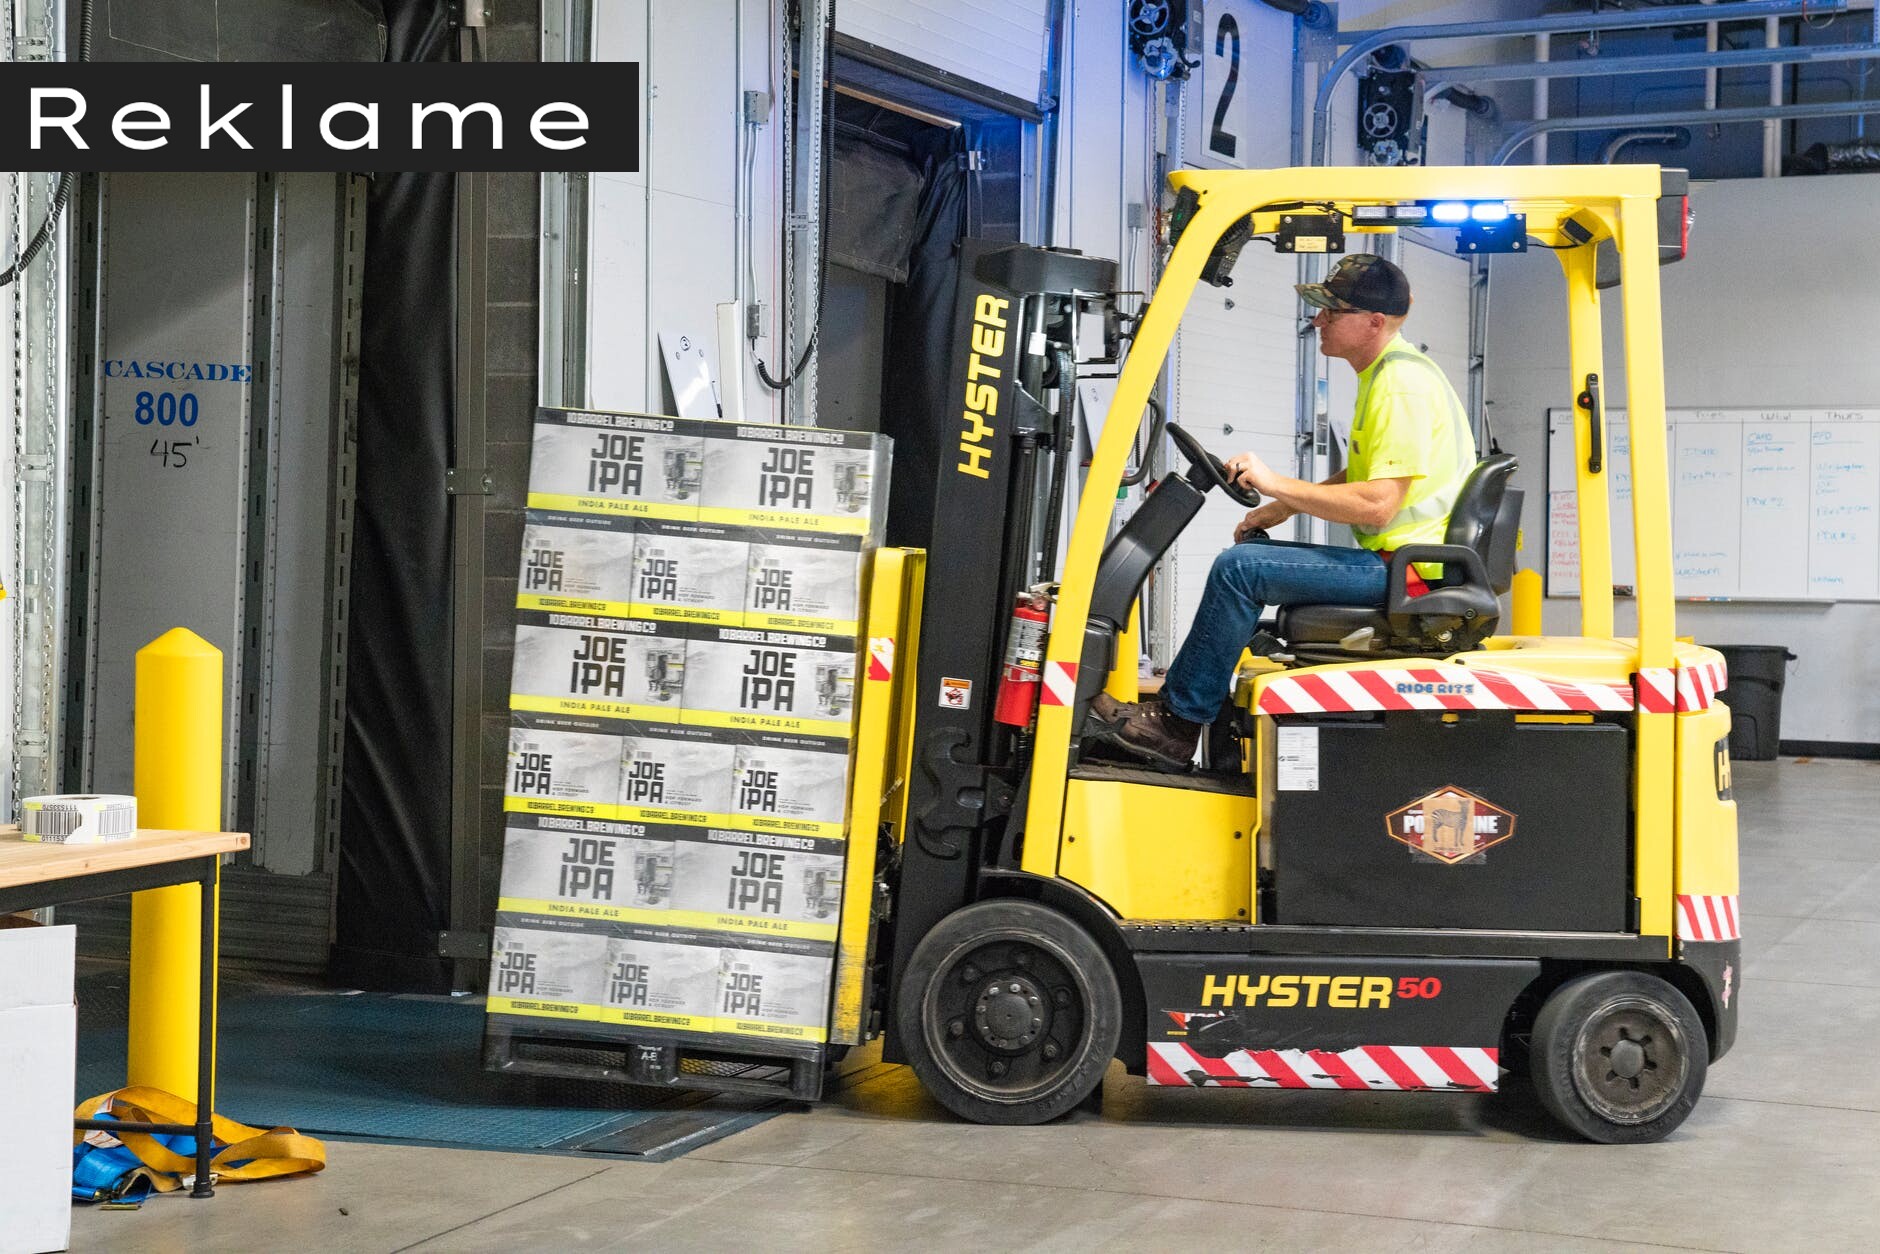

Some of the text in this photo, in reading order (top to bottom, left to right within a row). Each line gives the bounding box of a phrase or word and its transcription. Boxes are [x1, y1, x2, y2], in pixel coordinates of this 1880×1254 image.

[1210, 13, 1240, 158] 2
[105, 360, 252, 382] CASCADE
[957, 294, 1009, 479] HYSTER
[135, 391, 198, 426] 800
[150, 435, 199, 468] 45'
[591, 433, 645, 462] JOE
[762, 447, 814, 475] JOE
[588, 460, 643, 496] IPA
[758, 474, 813, 509] IPA
[578, 500, 604, 508] INDIA
[608, 502, 628, 510] PALE
[528, 550, 564, 568] JOE
[642, 559, 678, 578] JOE
[526, 567, 562, 591] IPA
[640, 577, 677, 600] IPA
[756, 569, 792, 587] JOE
[754, 587, 790, 610] IPA
[574, 635, 627, 663] JOE
[744, 650, 796, 678] JOE
[570, 662, 625, 697] IPA
[1397, 683, 1433, 693] RIDE
[740, 676, 794, 712] IPA
[560, 701, 586, 709] INDIA
[590, 704, 610, 712] PALE
[730, 716, 756, 724] INDIA
[516, 753, 552, 772] JOE
[629, 761, 665, 780] JOE
[514, 771, 551, 794] IPA
[627, 779, 663, 803] IPA
[742, 770, 778, 789] JOE
[740, 788, 776, 812] IPA
[562, 838, 616, 866] JOE
[731, 851, 785, 880] JOE
[559, 865, 614, 900] IPA
[728, 878, 782, 914] IPA
[549, 904, 574, 912] INDIA
[579, 907, 599, 915] PALE
[717, 918, 788, 930] INDIA PALE ALE
[500, 952, 536, 971] JOE
[613, 963, 649, 982] JOE
[498, 970, 535, 994] IPA
[610, 981, 648, 1006] IPA
[726, 973, 763, 992] JOE
[1201, 975, 1442, 1009] HYSTER 50
[724, 991, 760, 1015] IPA
